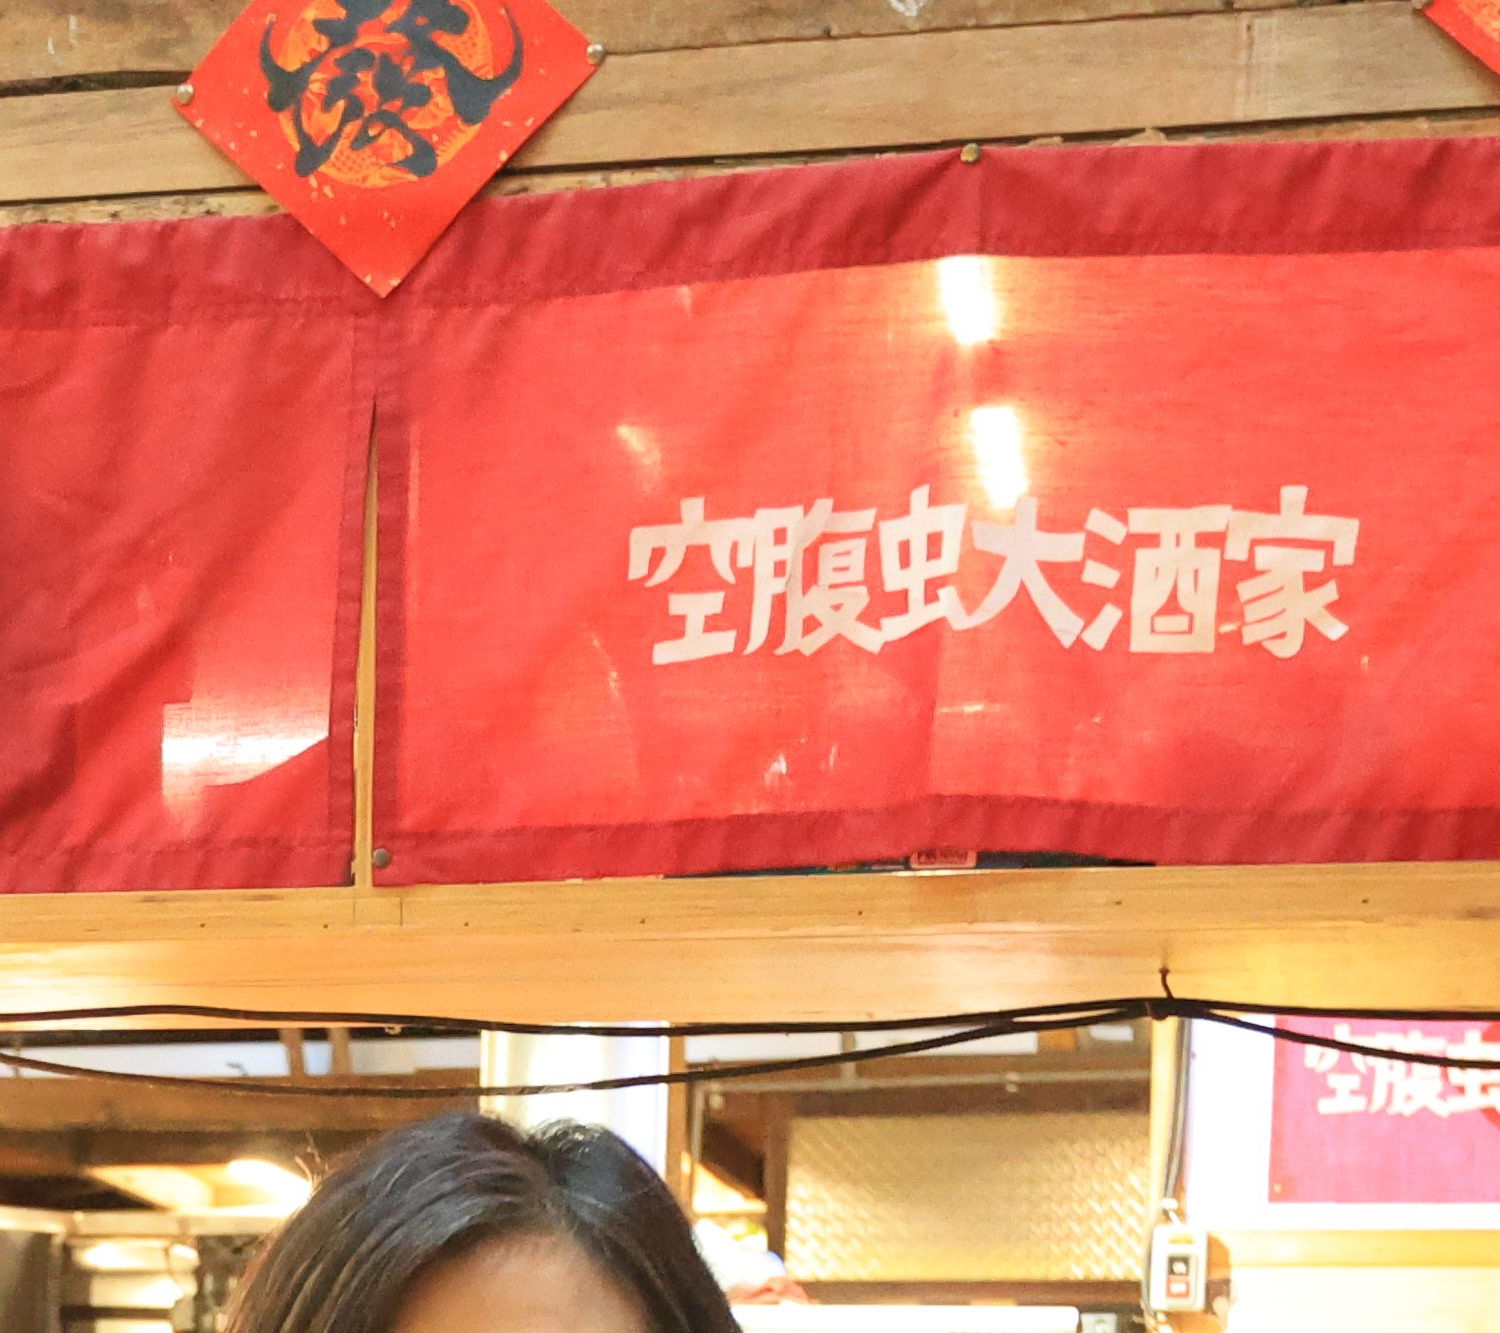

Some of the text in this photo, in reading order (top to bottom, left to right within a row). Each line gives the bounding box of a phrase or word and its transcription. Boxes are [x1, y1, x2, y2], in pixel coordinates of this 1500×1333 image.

[627, 484, 1361, 666] 空腹虫大酒家
